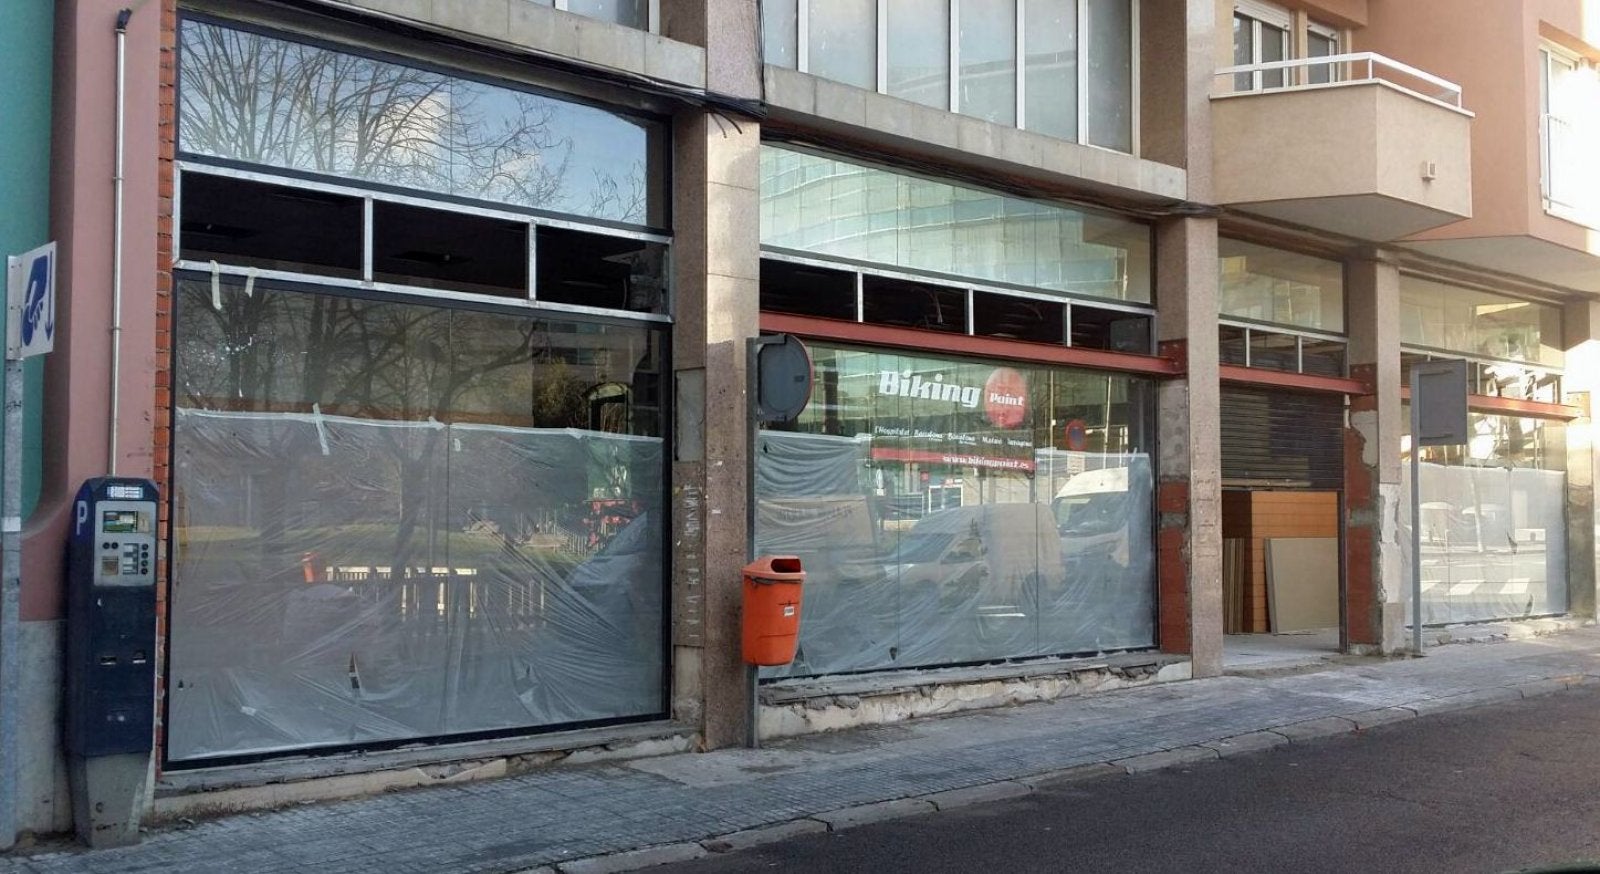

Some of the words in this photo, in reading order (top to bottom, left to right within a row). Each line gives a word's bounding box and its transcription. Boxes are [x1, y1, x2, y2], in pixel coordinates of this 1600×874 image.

[879, 369, 982, 408] Biking
[989, 392, 1025, 406] Point
[76, 500, 88, 536] P
